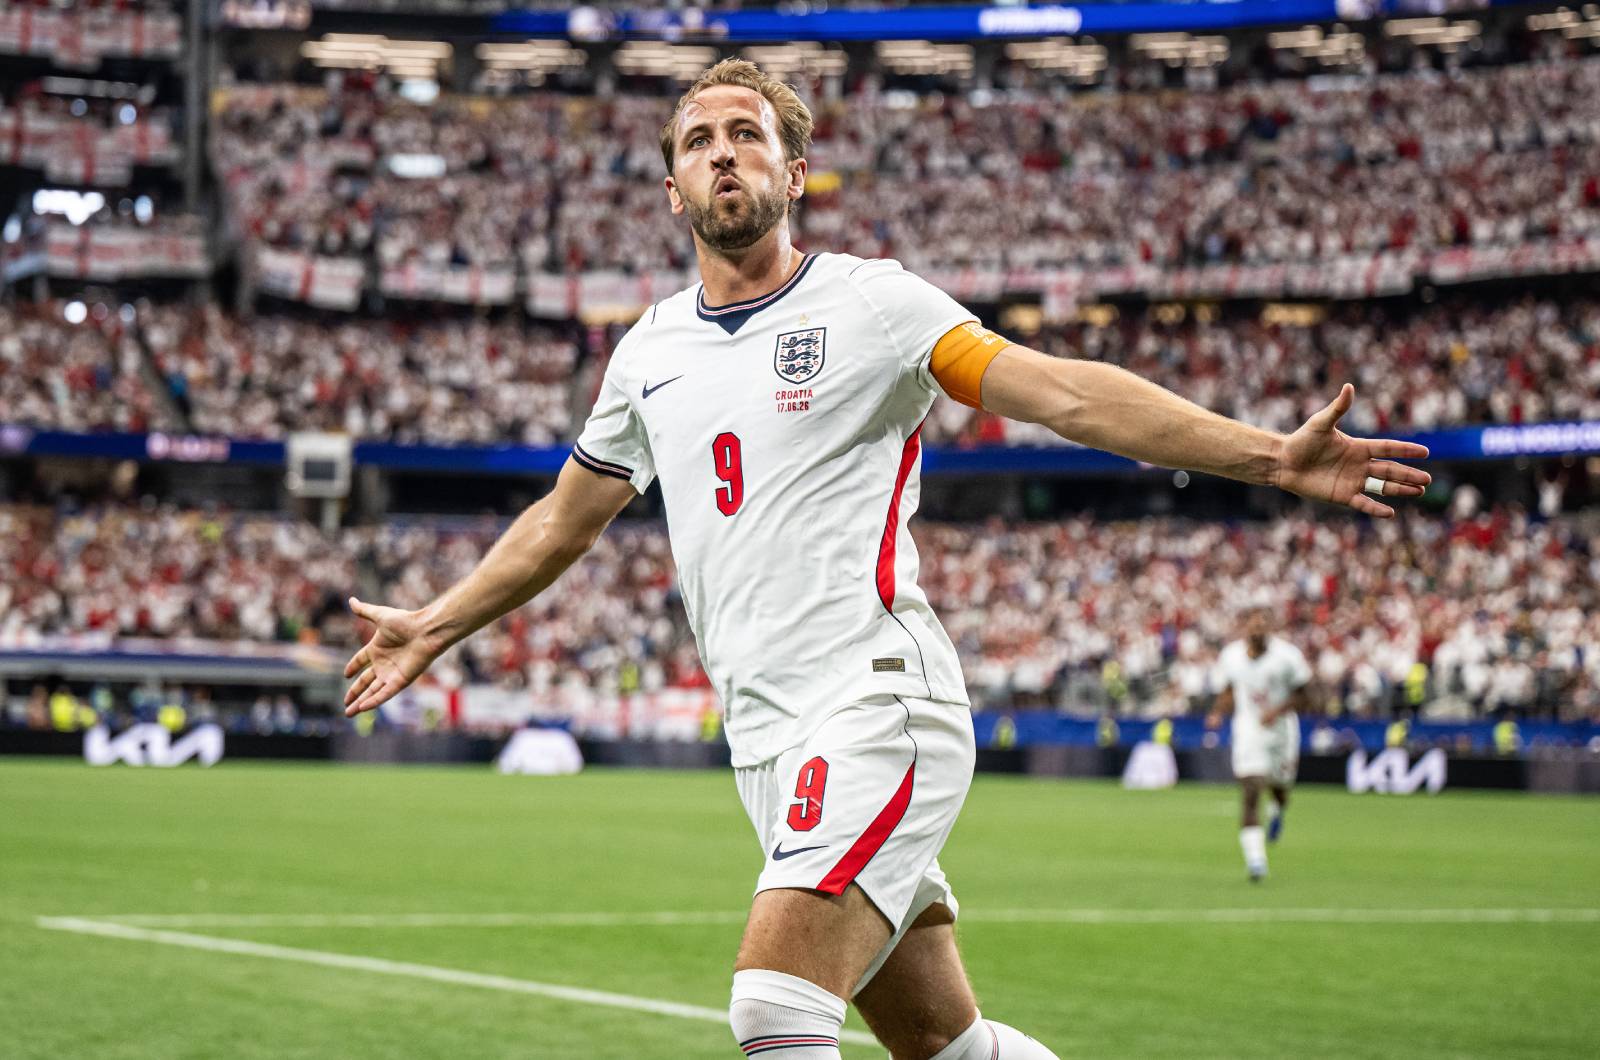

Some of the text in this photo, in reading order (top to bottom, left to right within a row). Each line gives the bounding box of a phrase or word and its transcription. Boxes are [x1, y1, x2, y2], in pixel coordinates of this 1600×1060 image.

[775, 389, 813, 401] CROATIA
[777, 401, 810, 413] 17.06.26
[712, 432, 744, 517] 9
[787, 756, 829, 832] 9
